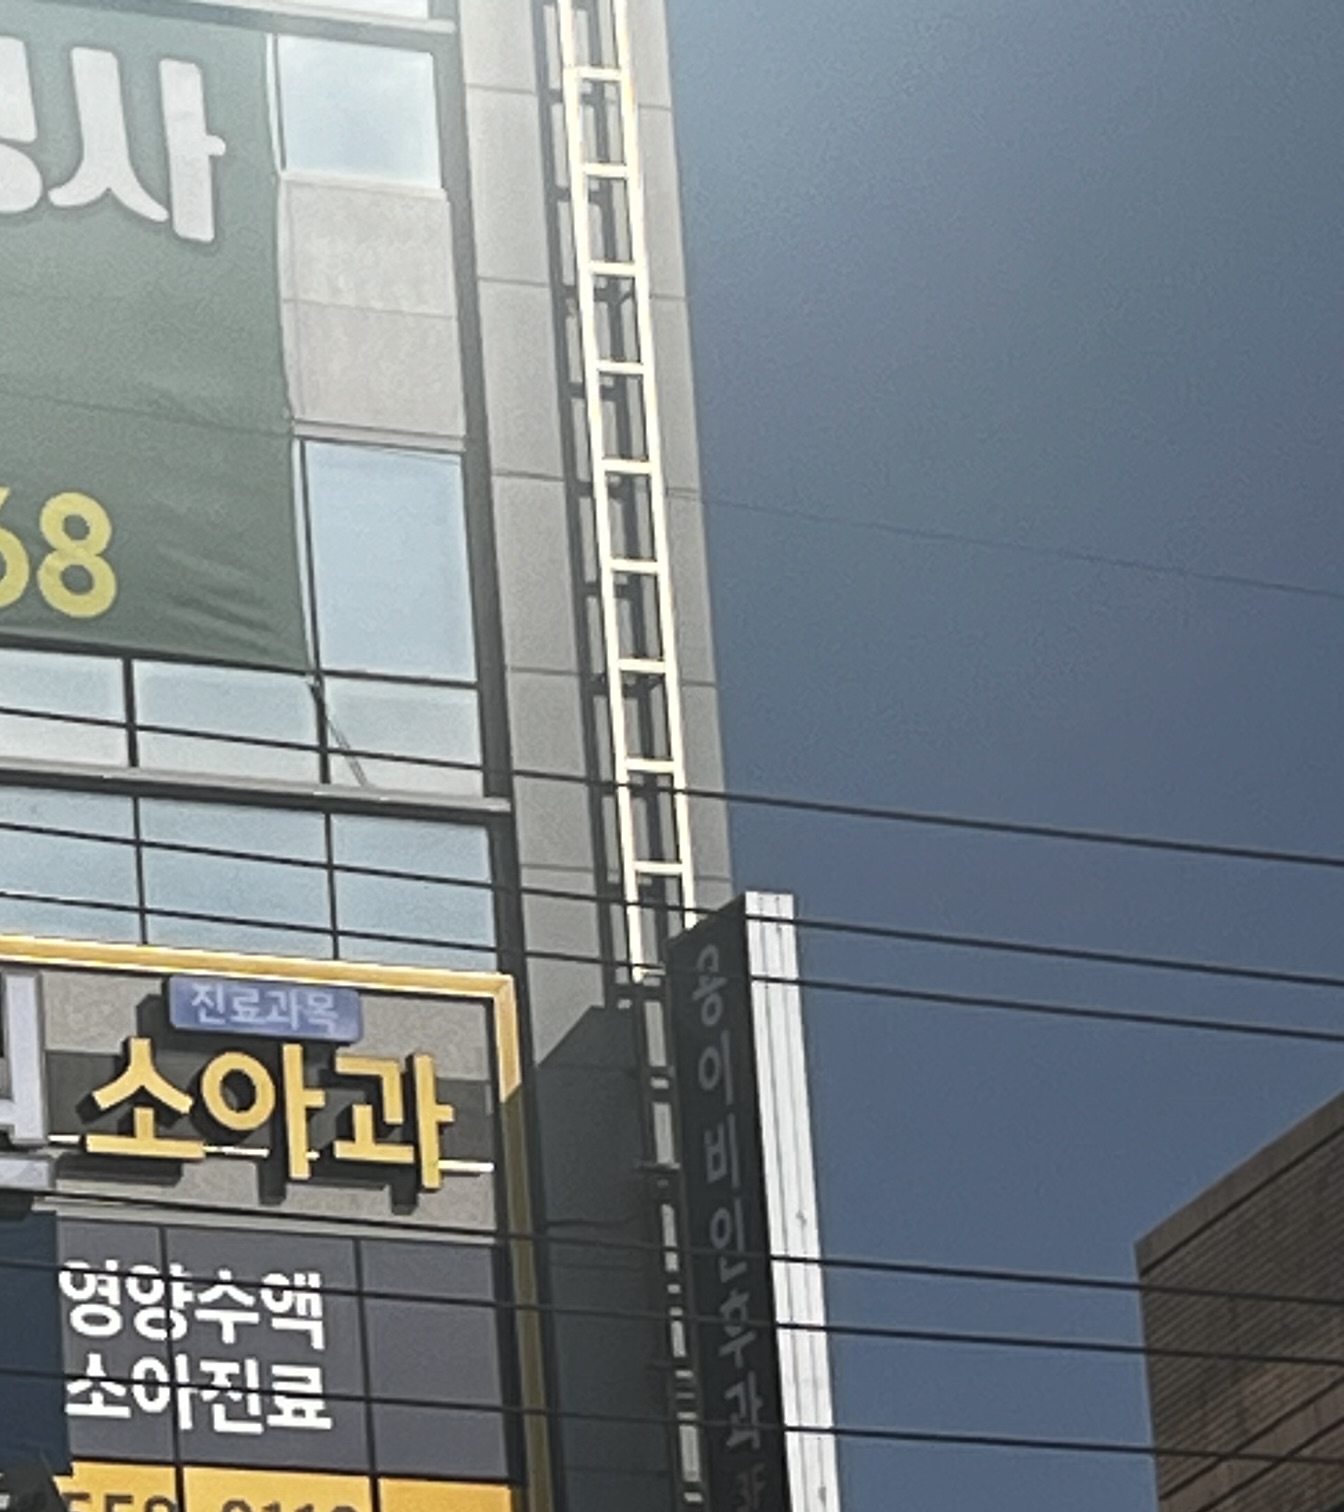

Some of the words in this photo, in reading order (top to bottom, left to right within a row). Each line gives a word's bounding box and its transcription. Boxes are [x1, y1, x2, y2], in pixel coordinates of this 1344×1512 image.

[85, 1037, 455, 1190] 소아과
[58, 1259, 326, 1350] 영양수액
[64, 1353, 333, 1435] 소아진료
